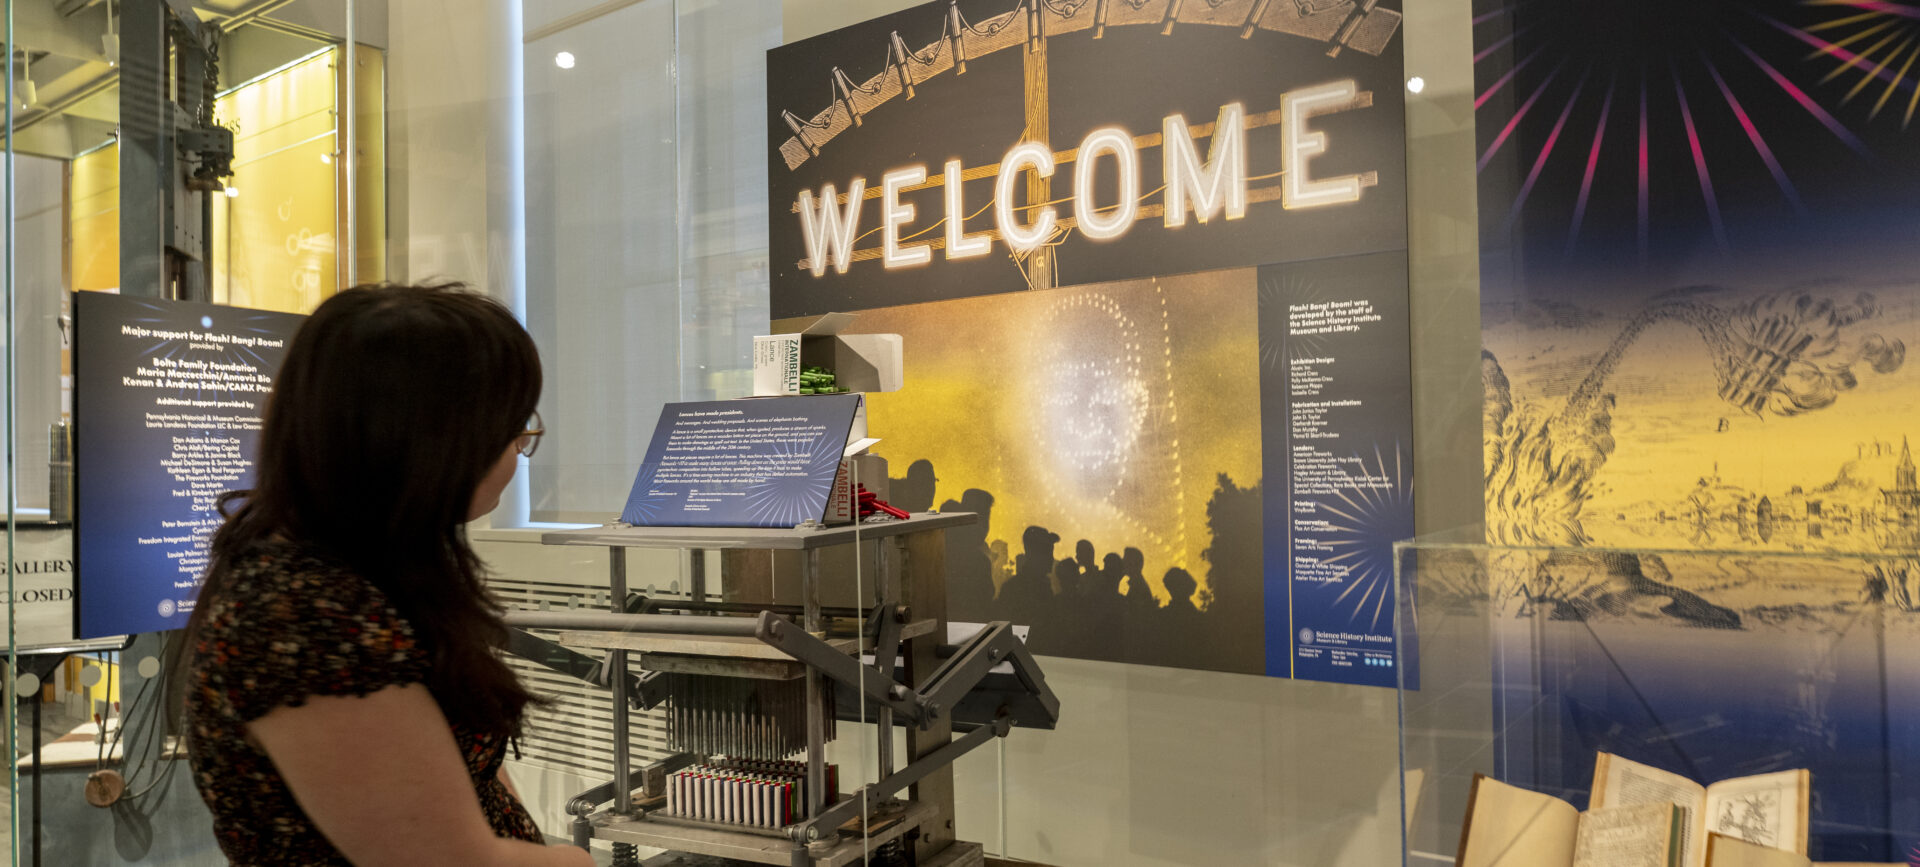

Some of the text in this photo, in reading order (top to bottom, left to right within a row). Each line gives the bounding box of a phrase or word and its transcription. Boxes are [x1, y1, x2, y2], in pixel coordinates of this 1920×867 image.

[798, 79, 1360, 278] WELCOME
[1290, 304, 1308, 312] Flash!
[1310, 302, 1329, 311] Bang!
[1331, 300, 1352, 308] Boom!
[1290, 311, 1324, 320] developed
[1336, 308, 1346, 316] the
[1348, 307, 1364, 315] staff
[1302, 319, 1325, 327] Science
[1327, 317, 1351, 325] History
[1334, 325, 1360, 333] Library.
[122, 325, 283, 347] Major support for Flash! Bang! Boom!
[190, 342, 224, 352] provided by
[153, 358, 257, 373] Bolte Family Foundation
[789, 340, 798, 391] ZAMBELLI
[137, 367, 165, 377] Maria
[258, 373, 271, 383] Bio
[123, 377, 153, 387] Kenan
[156, 378, 163, 387] &
[166, 378, 198, 389] Andrea
[157, 397, 254, 410] Additional support provided by
[1316, 631, 1392, 643] Science History Institute
